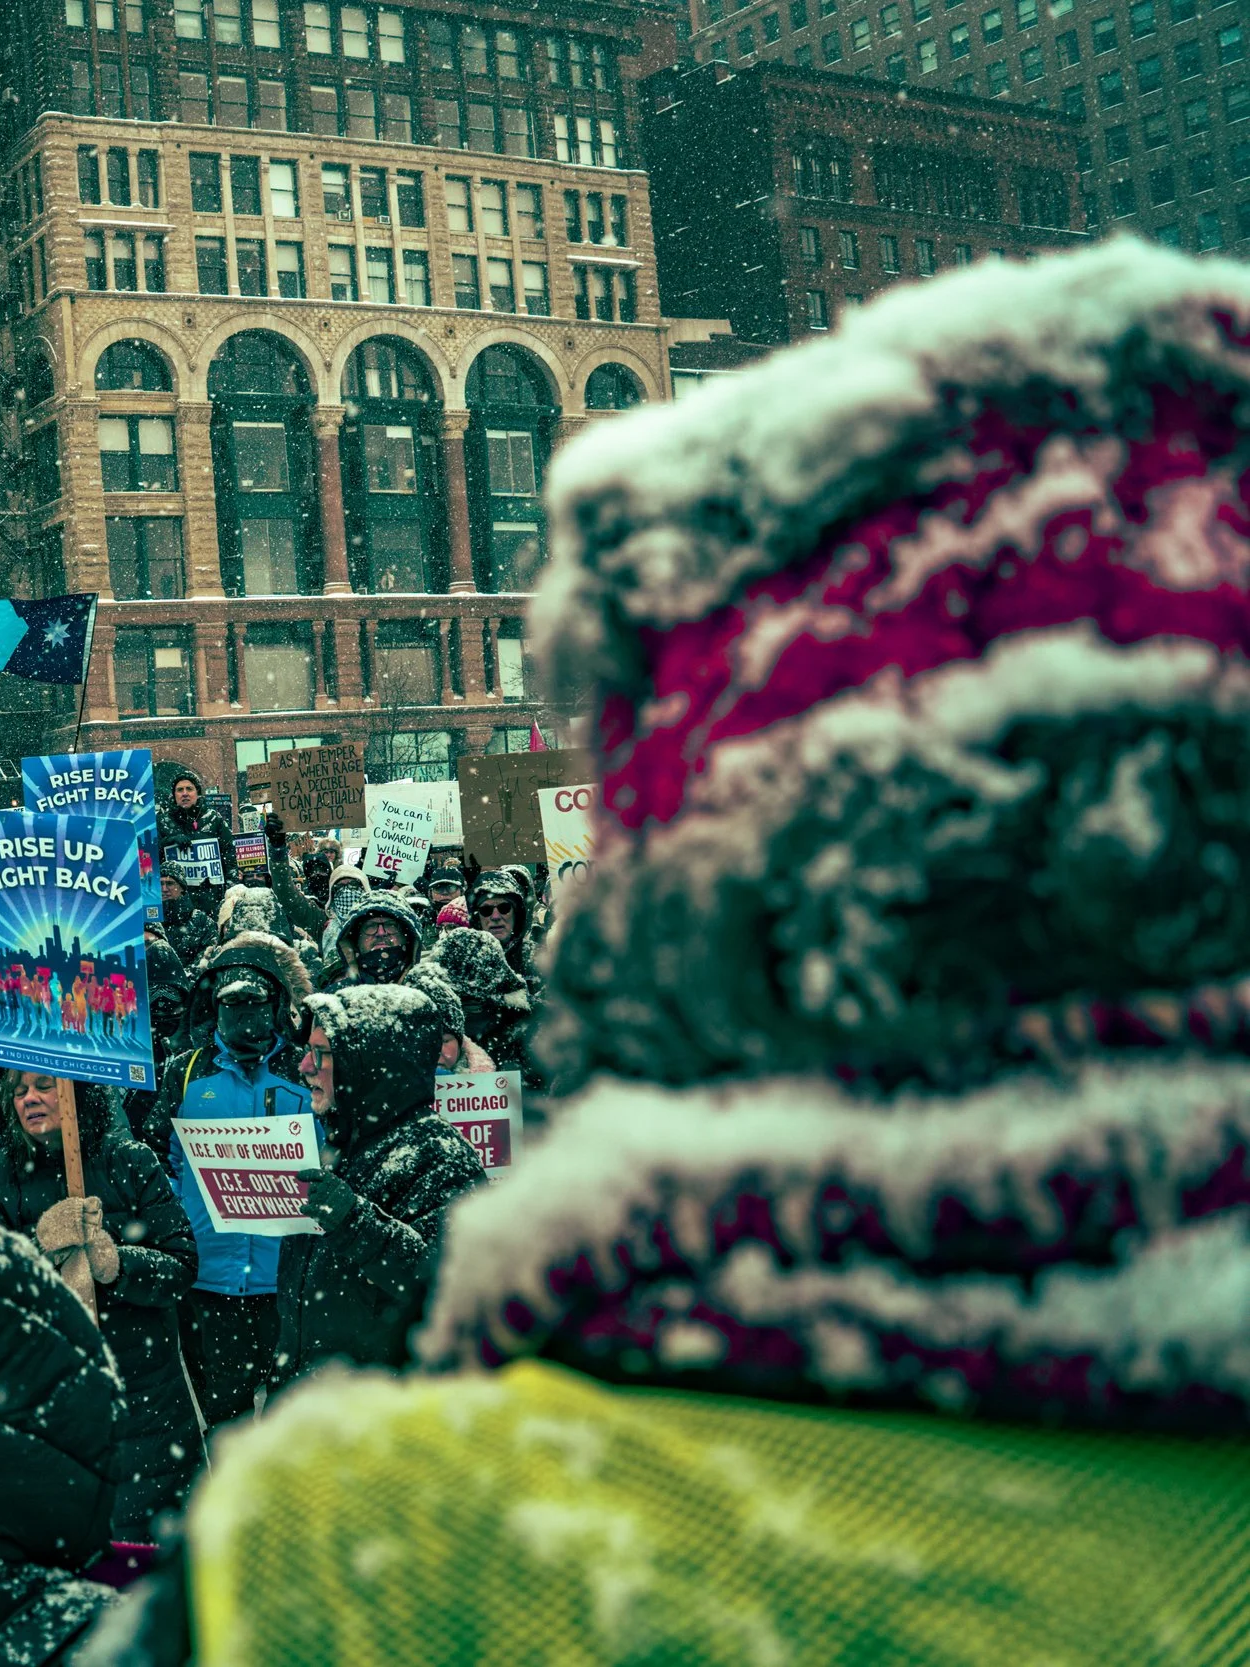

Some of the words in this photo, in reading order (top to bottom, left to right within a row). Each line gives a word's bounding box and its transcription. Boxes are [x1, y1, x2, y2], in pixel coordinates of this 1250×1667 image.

[299, 751, 312, 766] MY
[317, 745, 357, 763] TEMPER
[50, 769, 94, 788] RISE
[100, 768, 129, 782] UP
[299, 763, 328, 778] WHEN
[333, 759, 363, 775] RAGE
[276, 781, 290, 795] IS
[293, 780, 303, 794] A
[308, 776, 350, 792] DECIBEL
[36, 788, 89, 812] FIGHT
[94, 787, 146, 806] BACK
[280, 796, 286, 811] I
[289, 794, 311, 809] CAN
[316, 787, 364, 807] ACTUALLY
[382, 800, 401, 815] You
[299, 807, 321, 823] GET
[385, 818, 414, 832] spell
[64, 840, 103, 863] UP
[197, 844, 216, 860] OUT!
[375, 853, 402, 871] ICE
[54, 867, 129, 905] BACK
[6, 1051, 60, 1066] INDIVISIBLE
[62, 1060, 106, 1072] CHICAGO
[432, 1099, 442, 1112] F
[447, 1095, 508, 1112] CHICAGO
[470, 1125, 492, 1145] OF
[190, 1143, 215, 1158] I.C.E.
[215, 1144, 235, 1158] OUT
[237, 1144, 250, 1158] OF
[252, 1143, 304, 1159] CHICAGO
[212, 1172, 250, 1192] I.C.E.
[249, 1174, 279, 1193] OUT
[280, 1175, 300, 1194] OF
